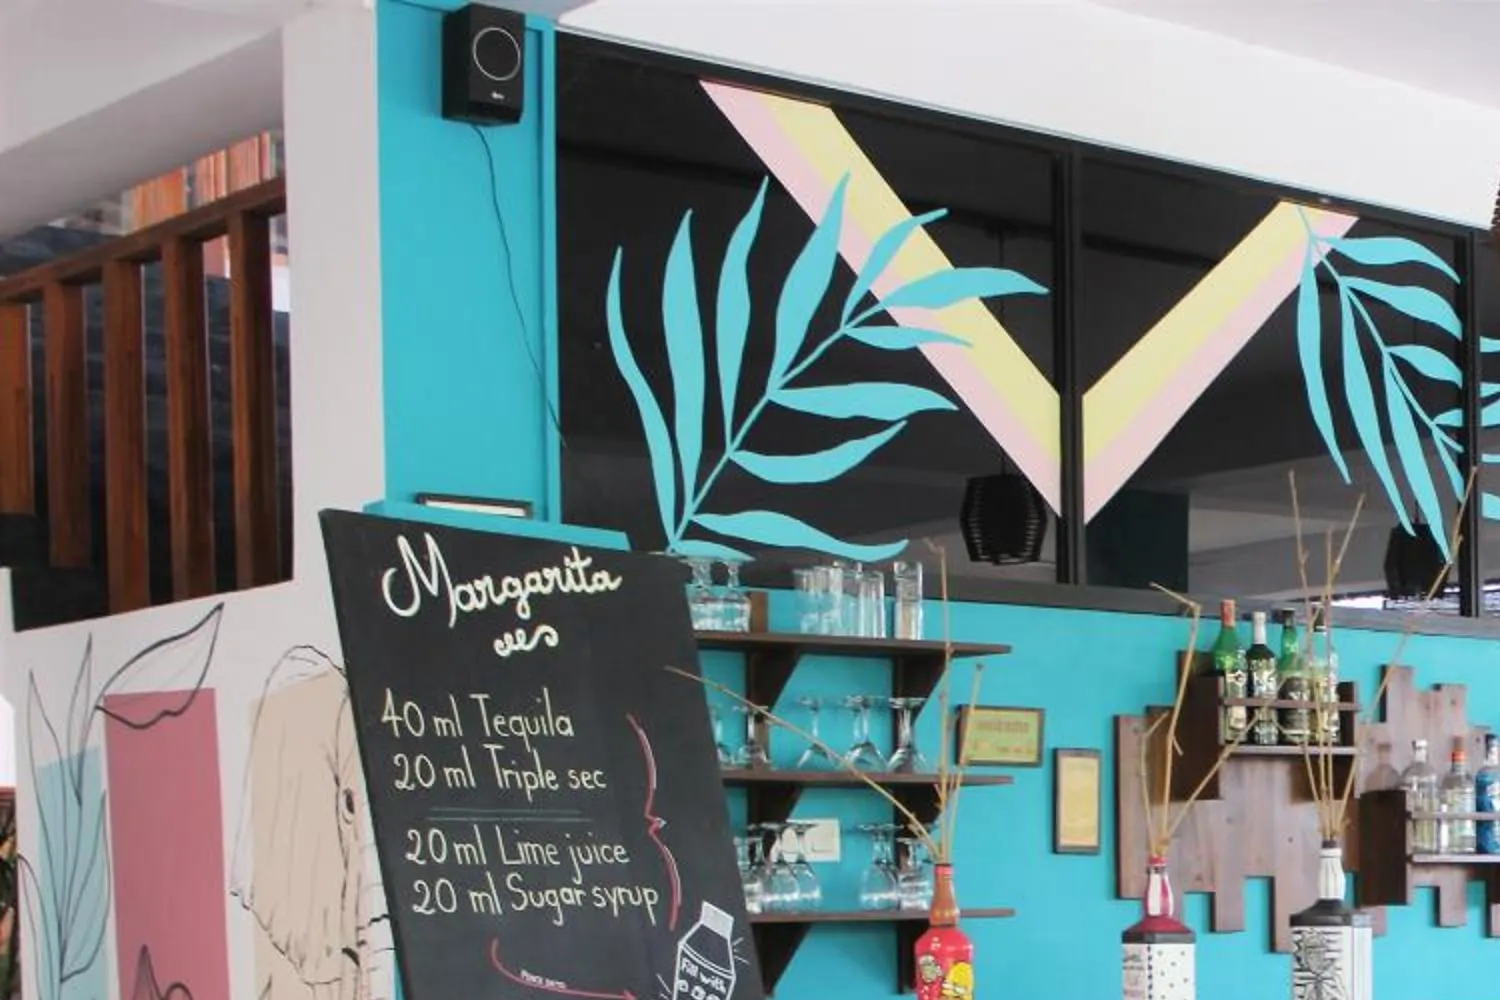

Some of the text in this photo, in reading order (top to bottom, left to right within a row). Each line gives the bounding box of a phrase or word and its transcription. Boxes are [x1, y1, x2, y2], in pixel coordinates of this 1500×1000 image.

[381, 531, 623, 629] Margarita
[381, 686, 575, 752] 40 ml Tequila
[393, 742, 607, 804] 20 ml Triple sec
[405, 823, 630, 884] 20 ml Lime juice
[412, 870, 660, 927] 20 ml Sugar syrup
